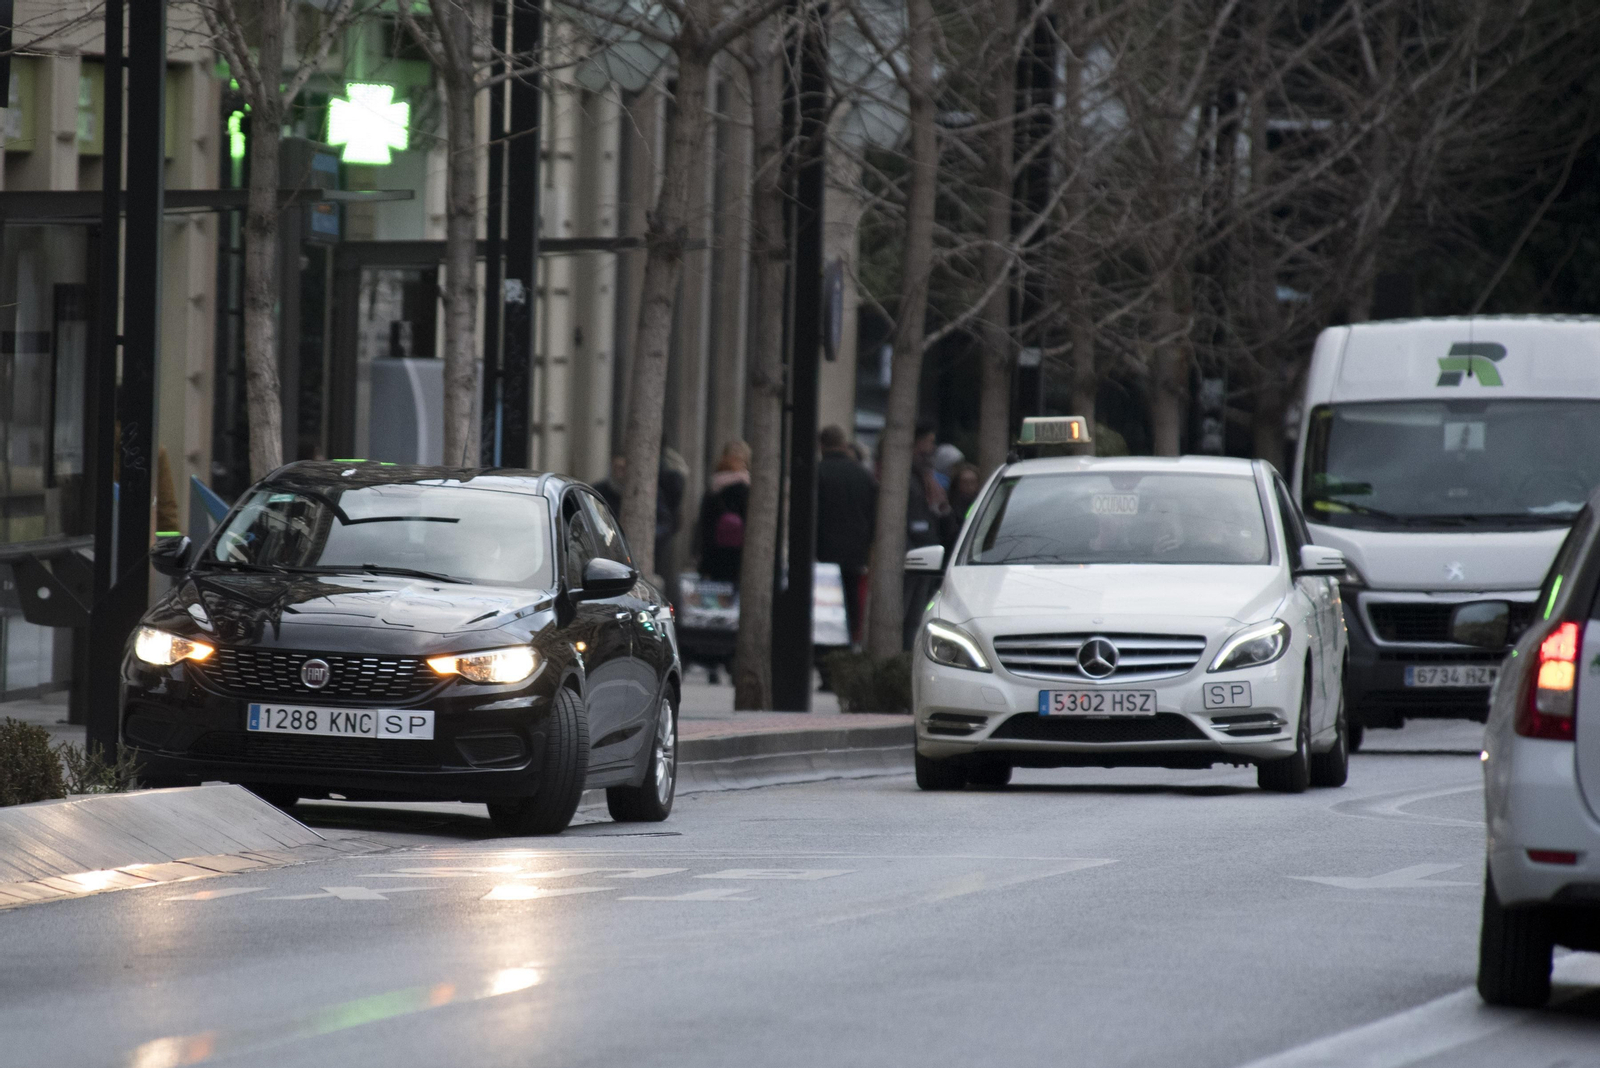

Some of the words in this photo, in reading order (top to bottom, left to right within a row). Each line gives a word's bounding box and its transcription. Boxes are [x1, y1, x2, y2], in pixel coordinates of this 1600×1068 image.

[1417, 668, 1460, 683] 6734
[1054, 694, 1105, 712] 5302
[1112, 693, 1151, 712] HSZ
[1210, 685, 1244, 704] SP
[264, 707, 317, 731] 1288
[329, 711, 372, 734] KNC
[384, 715, 427, 734] SP
